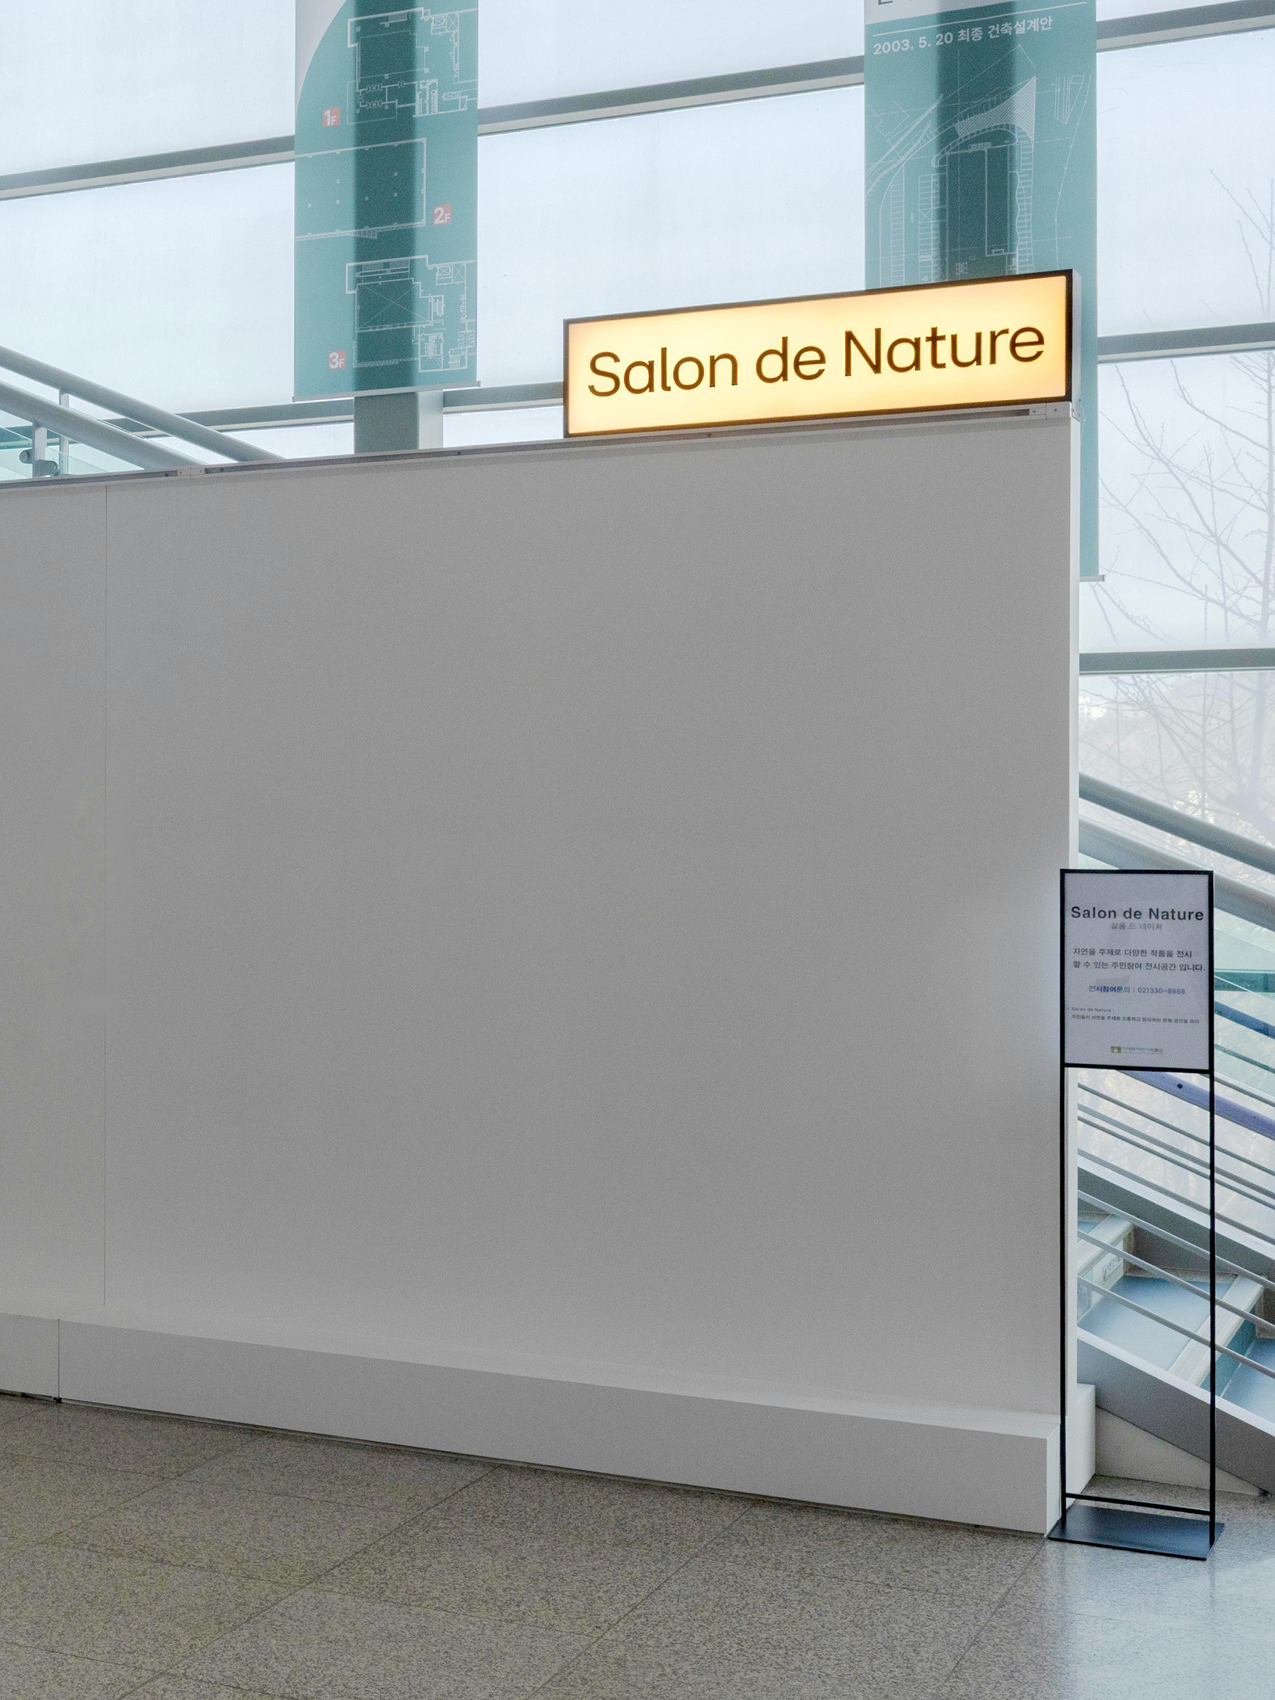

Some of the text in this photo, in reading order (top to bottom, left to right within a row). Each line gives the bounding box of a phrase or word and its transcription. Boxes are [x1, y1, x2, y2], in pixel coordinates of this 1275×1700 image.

[873, 16, 1053, 55] 2003. 5. 20 최종 건축설계안
[324, 109, 338, 127] 1F
[434, 207, 451, 225] 2F
[328, 351, 345, 370] 3F
[587, 325, 1046, 398] Salon de Nature
[1070, 906, 1205, 921] Salon de Nature
[1128, 922, 1137, 930] 드
[1139, 922, 1163, 931] 네이처
[1073, 947, 1192, 958] 자연을 주제로 다양한 작품을 전시
[1083, 961, 1091, 969] 수
[1093, 961, 1108, 969] 있는
[1145, 962, 1176, 971] 전시공간
